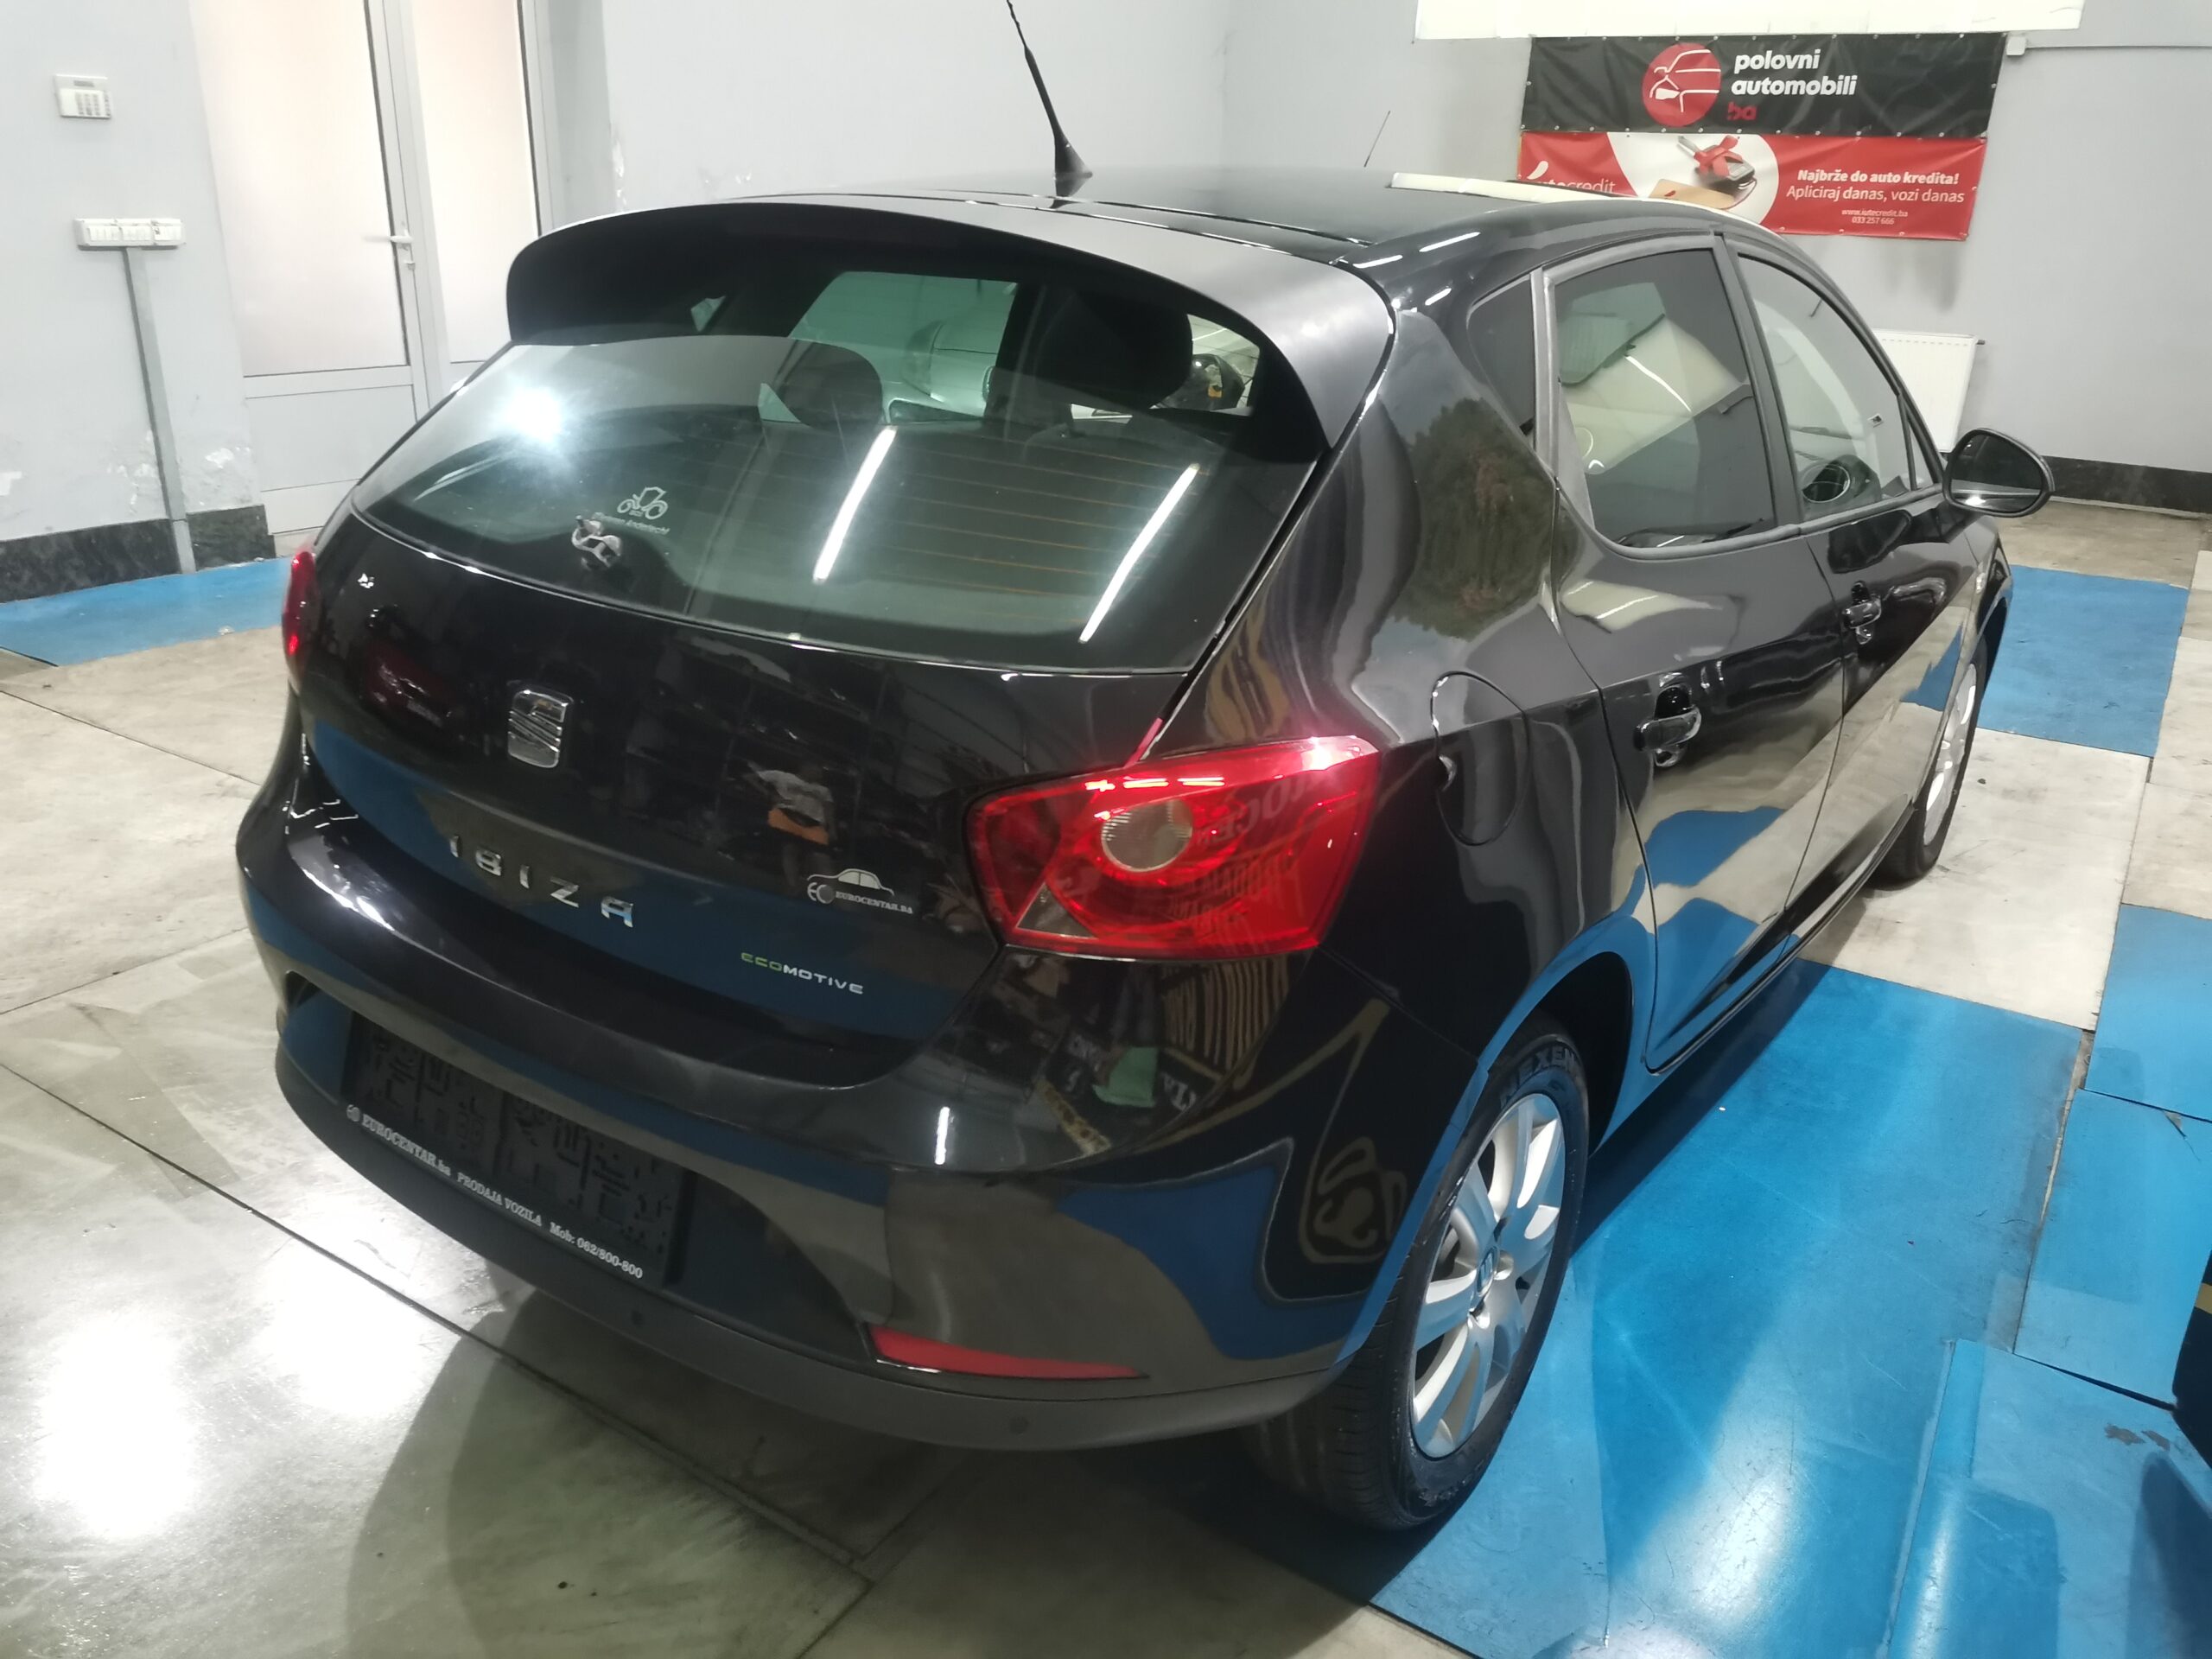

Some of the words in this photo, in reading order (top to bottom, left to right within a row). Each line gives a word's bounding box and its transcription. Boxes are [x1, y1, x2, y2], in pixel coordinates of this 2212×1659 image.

[1733, 48, 1821, 74] polovni
[1731, 74, 1858, 96] automobili
[1797, 169, 1848, 184] Najbrže
[1850, 170, 1868, 182] do
[1870, 172, 1901, 183] auto
[1903, 171, 1959, 185] kredita!
[1786, 184, 1840, 201] Apliciraj
[1842, 186, 1887, 202] danas,
[1891, 188, 1918, 201] vozi
[1921, 188, 1965, 203] danas
[449, 835, 634, 929] IBIZA
[741, 952, 864, 995] ECOMOTIVE
[361, 1113, 452, 1177] EUROCENTAR.ba
[456, 1172, 503, 1205] PRODAJA
[504, 1197, 543, 1227] VOZILA
[549, 1221, 575, 1244] Mob:
